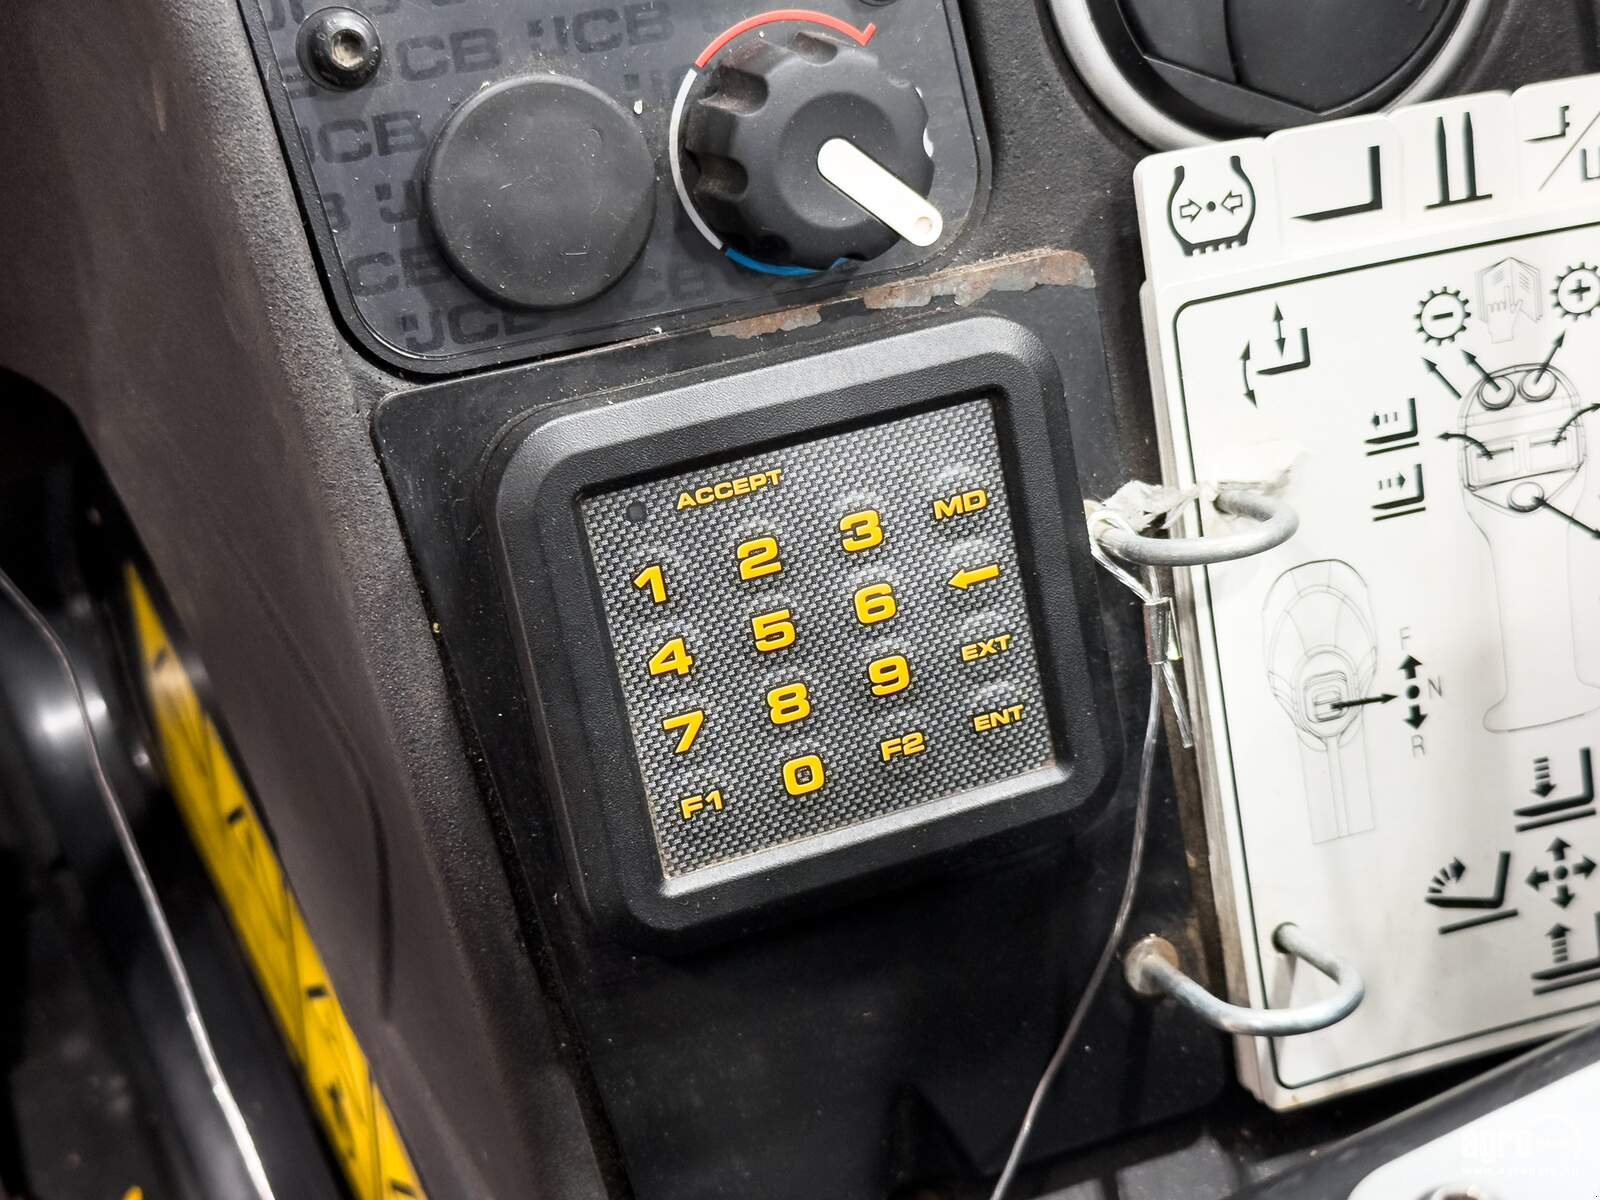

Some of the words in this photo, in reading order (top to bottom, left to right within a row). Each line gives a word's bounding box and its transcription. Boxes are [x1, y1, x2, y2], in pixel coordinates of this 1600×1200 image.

[386, 28, 501, 82] CB
[677, 469, 785, 511] ACCEPT
[935, 489, 988, 520] MD
[840, 511, 885, 552] 3
[738, 537, 783, 581] 2
[634, 566, 667, 603] 1
[855, 583, 898, 625] 6
[751, 609, 796, 652] 5
[963, 636, 1011, 662] EXT
[649, 639, 694, 676] 4
[868, 655, 911, 696] 9
[767, 682, 811, 725] 8
[1426, 676, 1444, 698] N
[662, 711, 705, 753] 7
[975, 705, 1025, 732] ENT
[881, 731, 926, 762] F2
[783, 755, 825, 796] 0
[681, 791, 723, 819] F1
